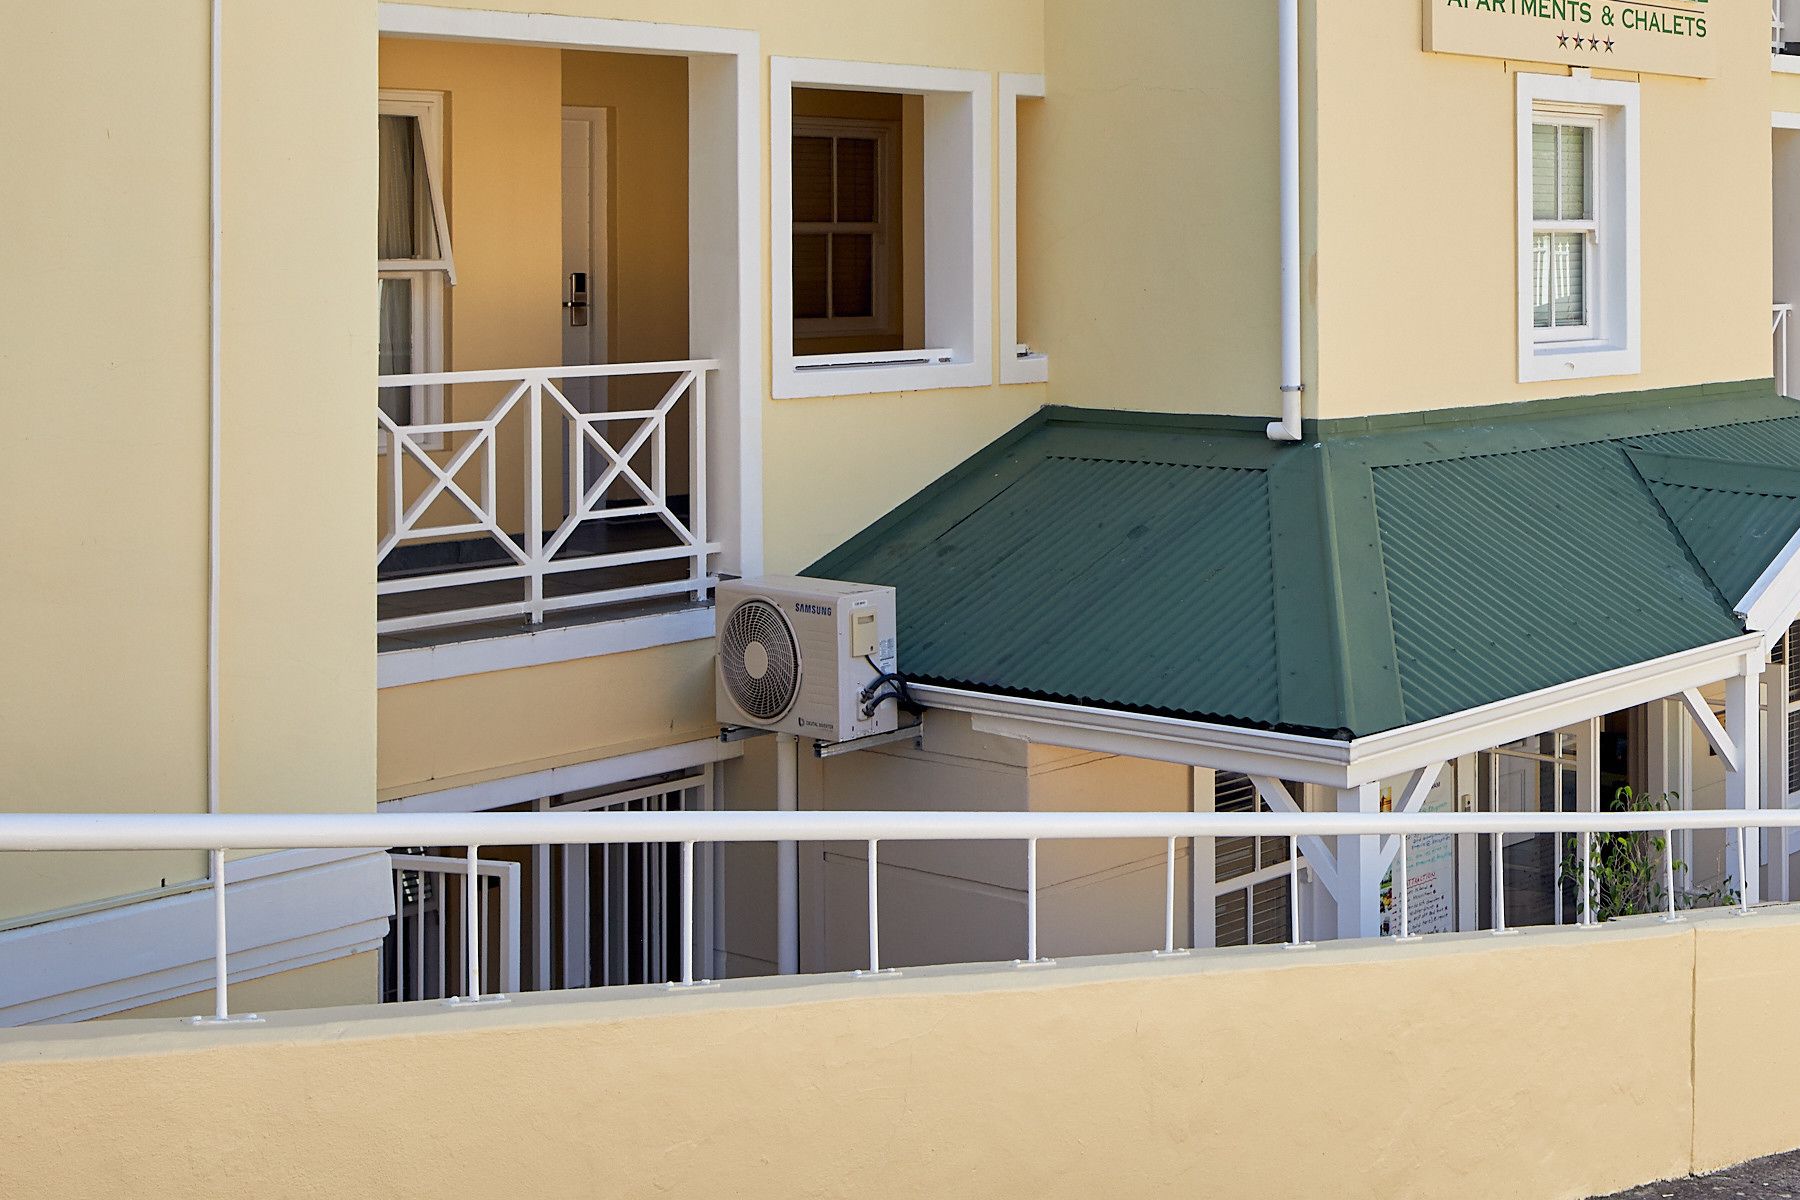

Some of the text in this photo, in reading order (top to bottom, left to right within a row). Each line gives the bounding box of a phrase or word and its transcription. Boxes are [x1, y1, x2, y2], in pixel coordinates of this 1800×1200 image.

[1601, 5, 1615, 27] &
[1621, 8, 1707, 38] CHALETS
[795, 602, 832, 617] SAMSUNG
